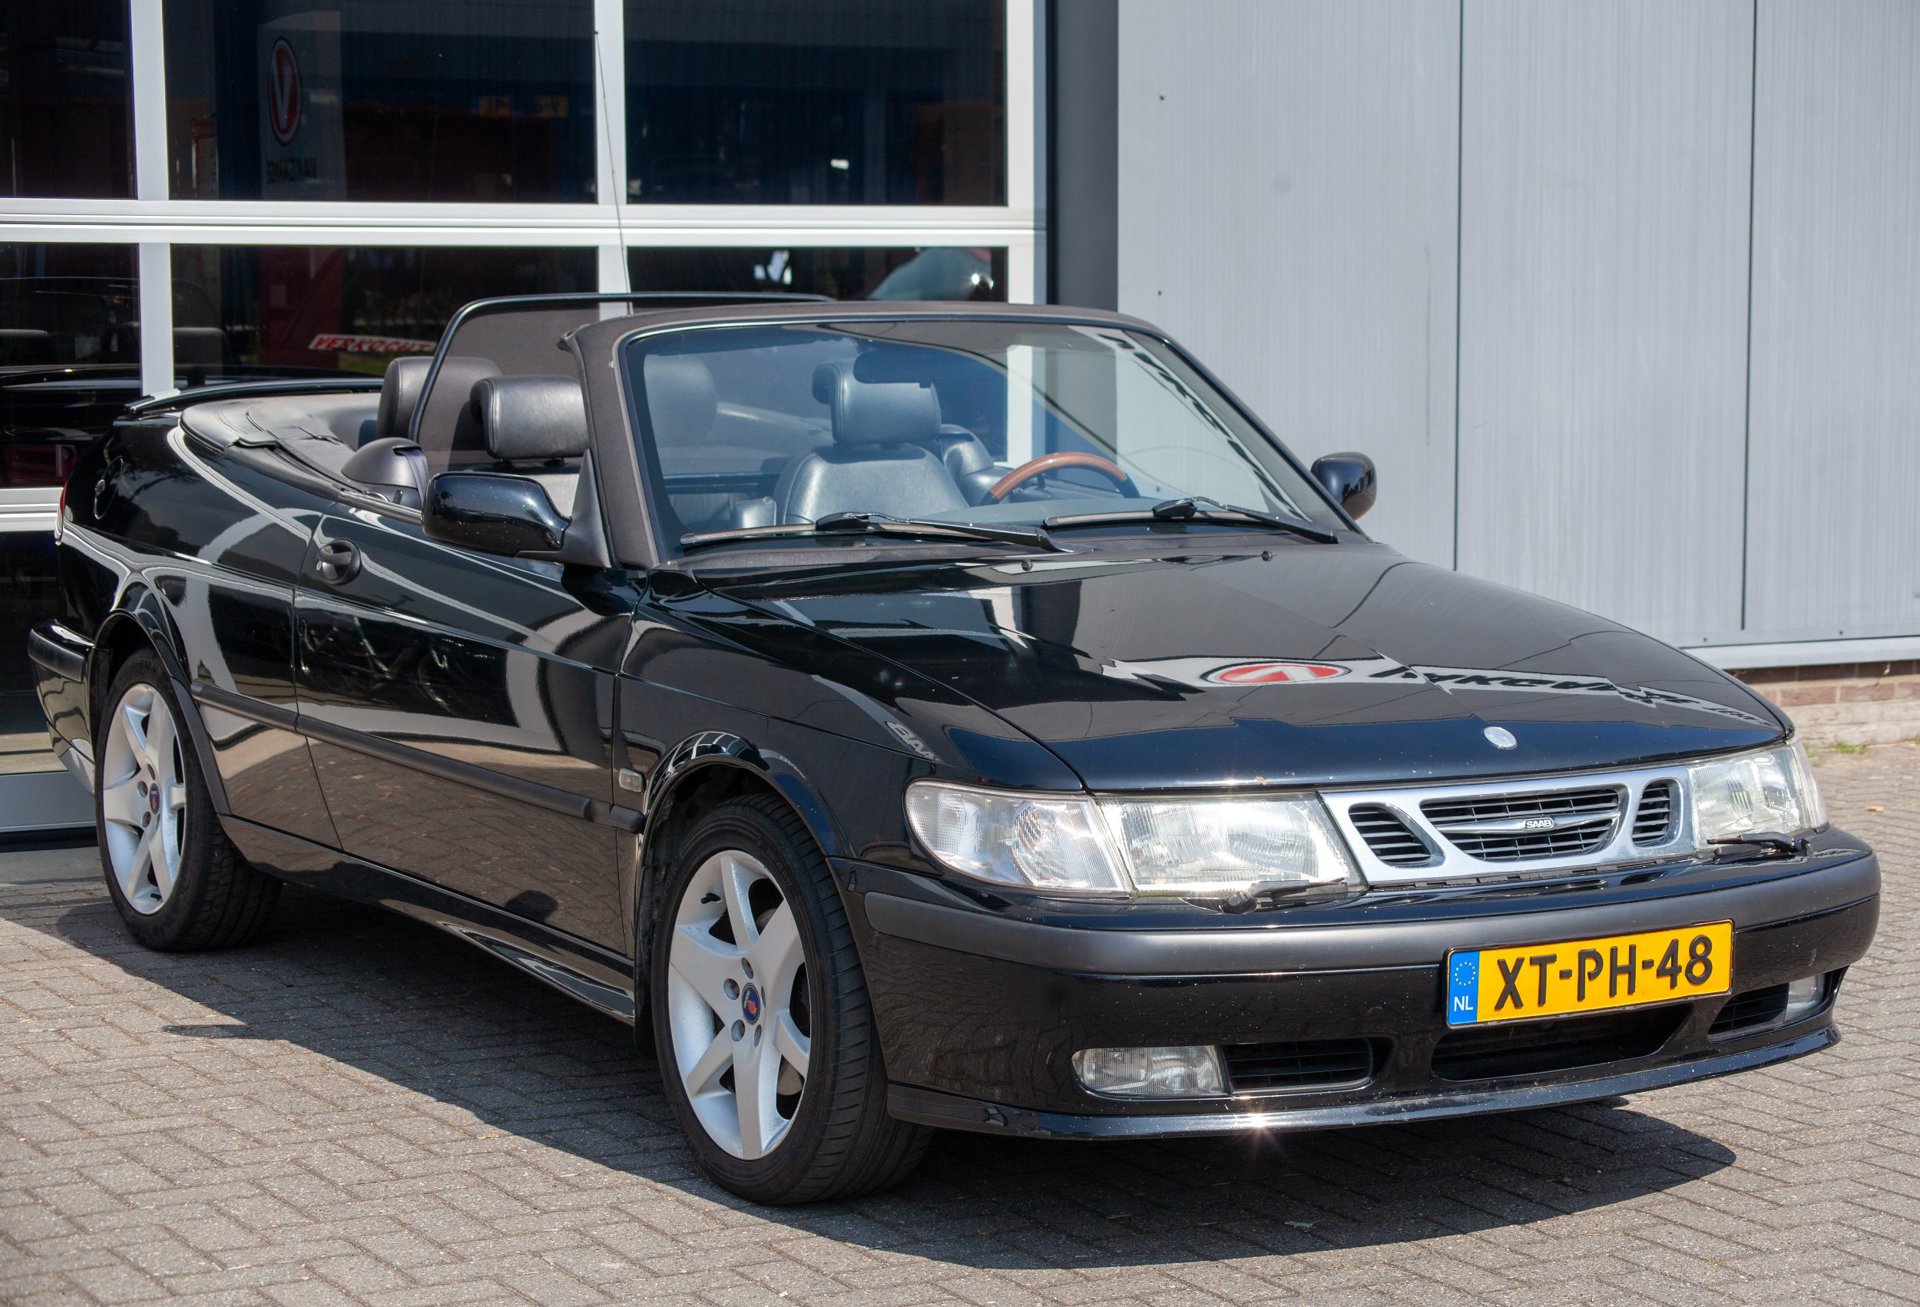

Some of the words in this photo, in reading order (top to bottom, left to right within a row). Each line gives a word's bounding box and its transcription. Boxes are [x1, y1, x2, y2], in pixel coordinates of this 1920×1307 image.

[1525, 818, 1553, 829] SAAB
[1494, 934, 1713, 1010] XT-PH-48
[1453, 995, 1474, 1012] NL
